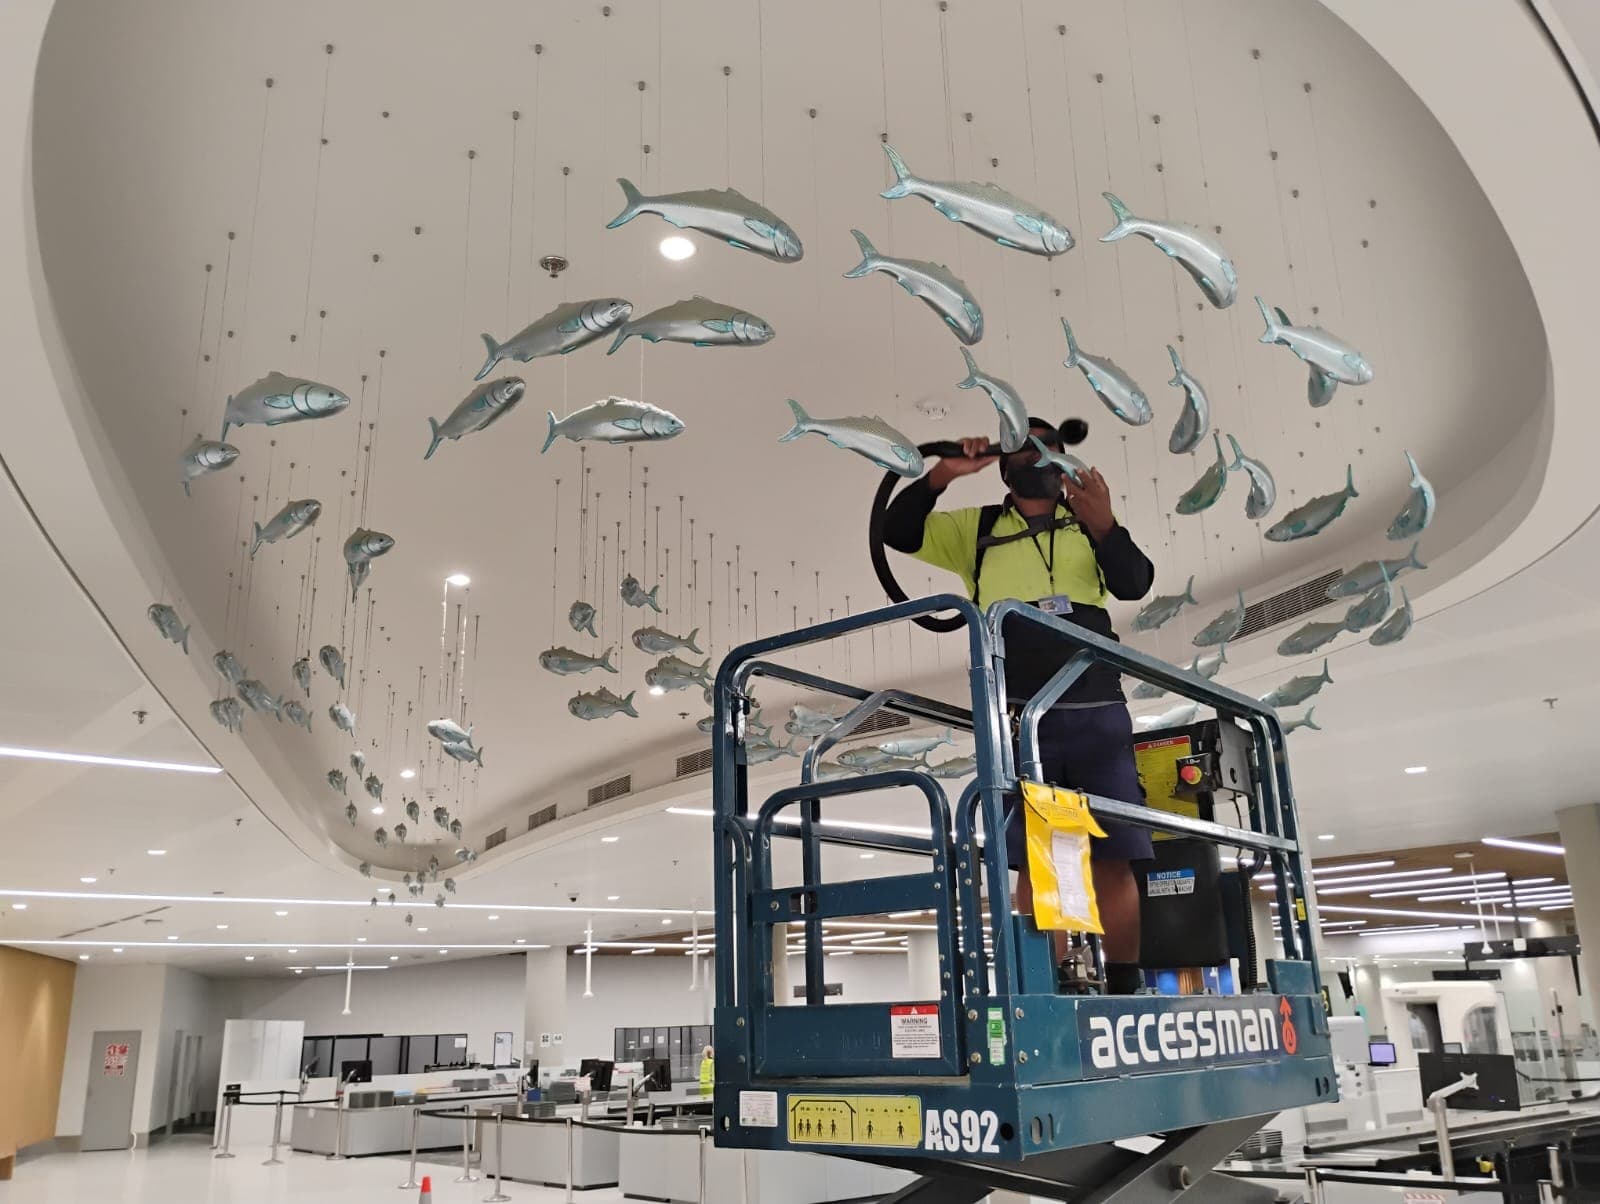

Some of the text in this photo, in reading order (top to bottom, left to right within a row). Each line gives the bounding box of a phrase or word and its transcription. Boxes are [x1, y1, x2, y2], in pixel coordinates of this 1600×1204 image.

[1157, 871, 1182, 880] NOTICE
[901, 1017, 928, 1025] WARNING
[1089, 1008, 1279, 1069] accessman
[925, 1109, 1000, 1154] AS92
